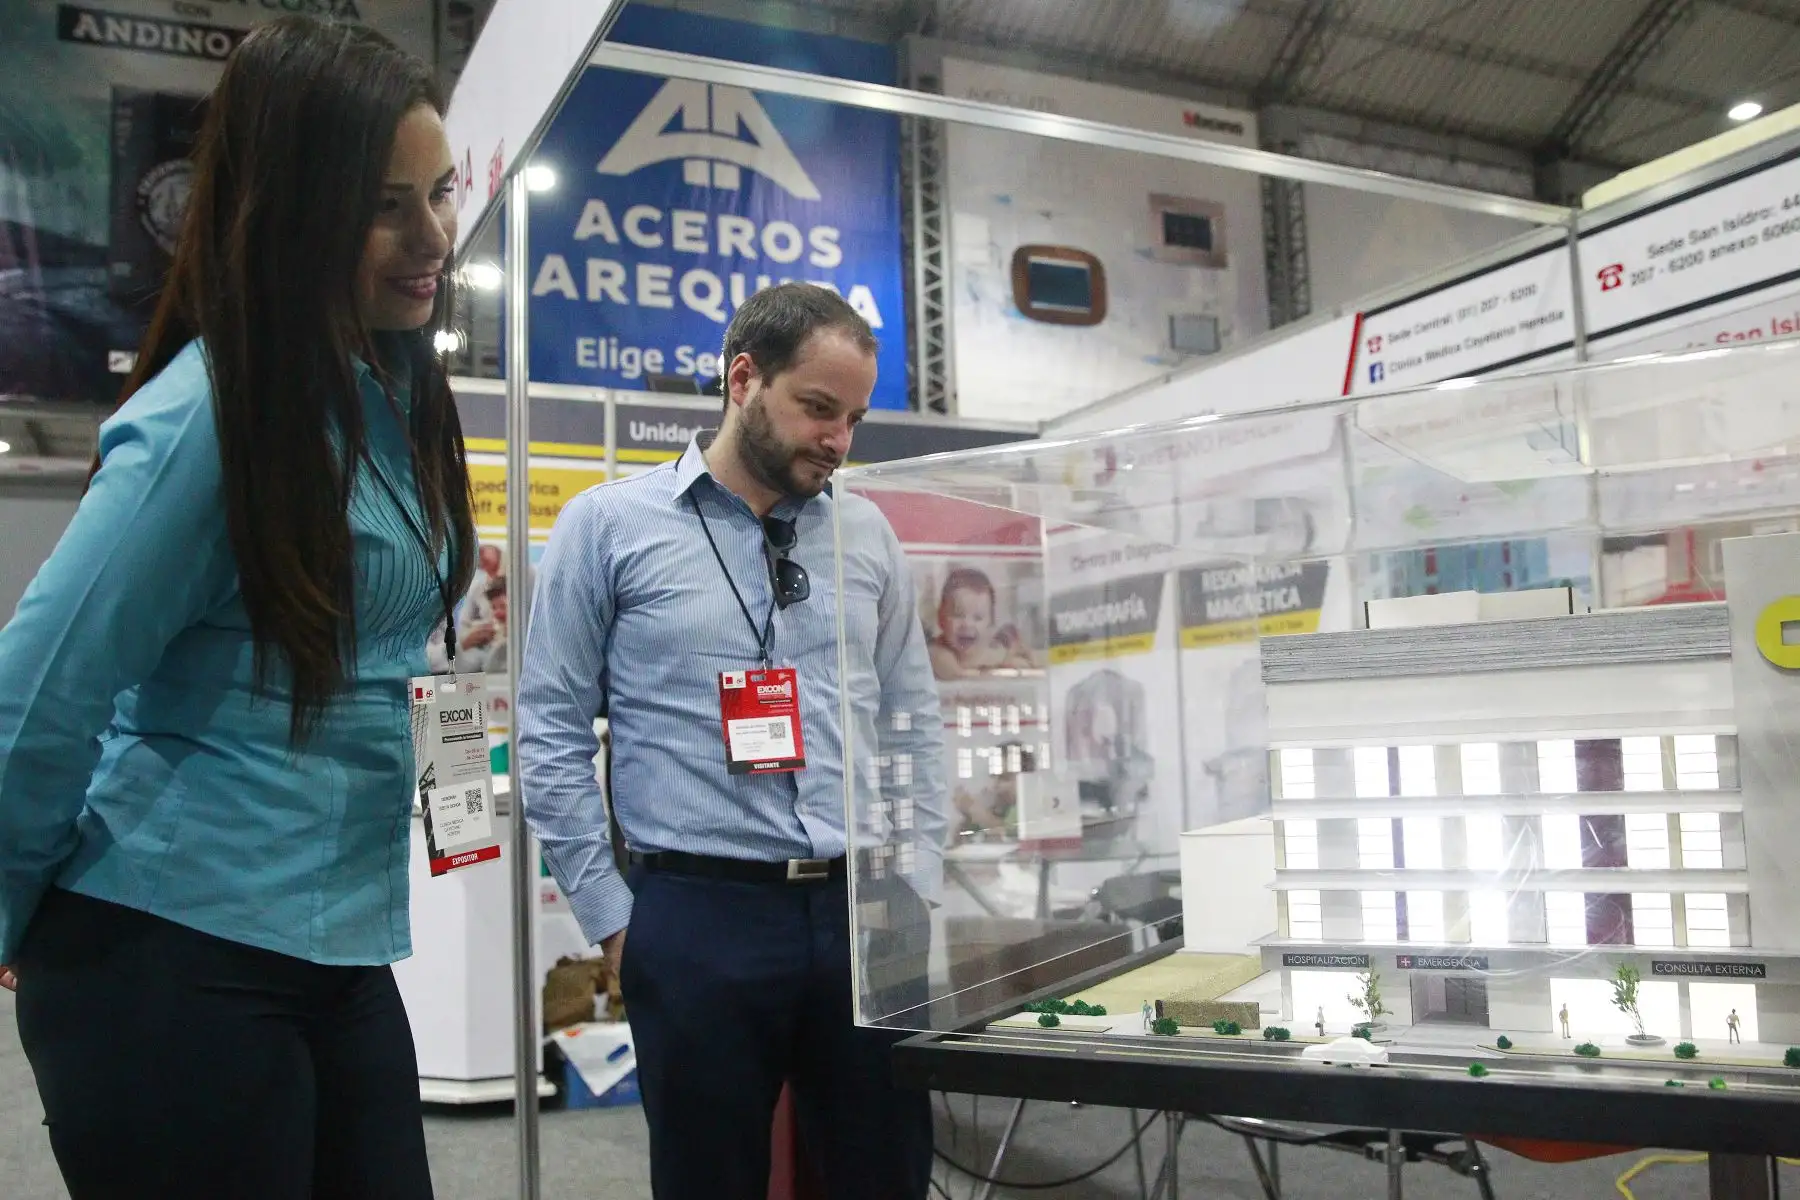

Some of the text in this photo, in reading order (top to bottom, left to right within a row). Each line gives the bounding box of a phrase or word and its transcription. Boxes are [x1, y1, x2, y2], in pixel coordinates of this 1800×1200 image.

[70, 13, 232, 57] ANDINO
[574, 199, 843, 269] ACEROS
[1648, 237, 1685, 259] Sede
[1688, 225, 1719, 246] San
[1631, 266, 1656, 287] 207
[1668, 251, 1705, 274] 6200
[1709, 235, 1758, 261] anexo
[1388, 327, 1412, 345] Sede
[576, 337, 663, 379] Elige
[440, 708, 473, 723] EXCON
[753, 762, 780, 770] VISITANTE
[452, 853, 479, 865] EXPOSITOR
[1417, 958, 1481, 968] EMERGENCIA
[1655, 963, 1763, 976] CONSULTA EXTERNA
